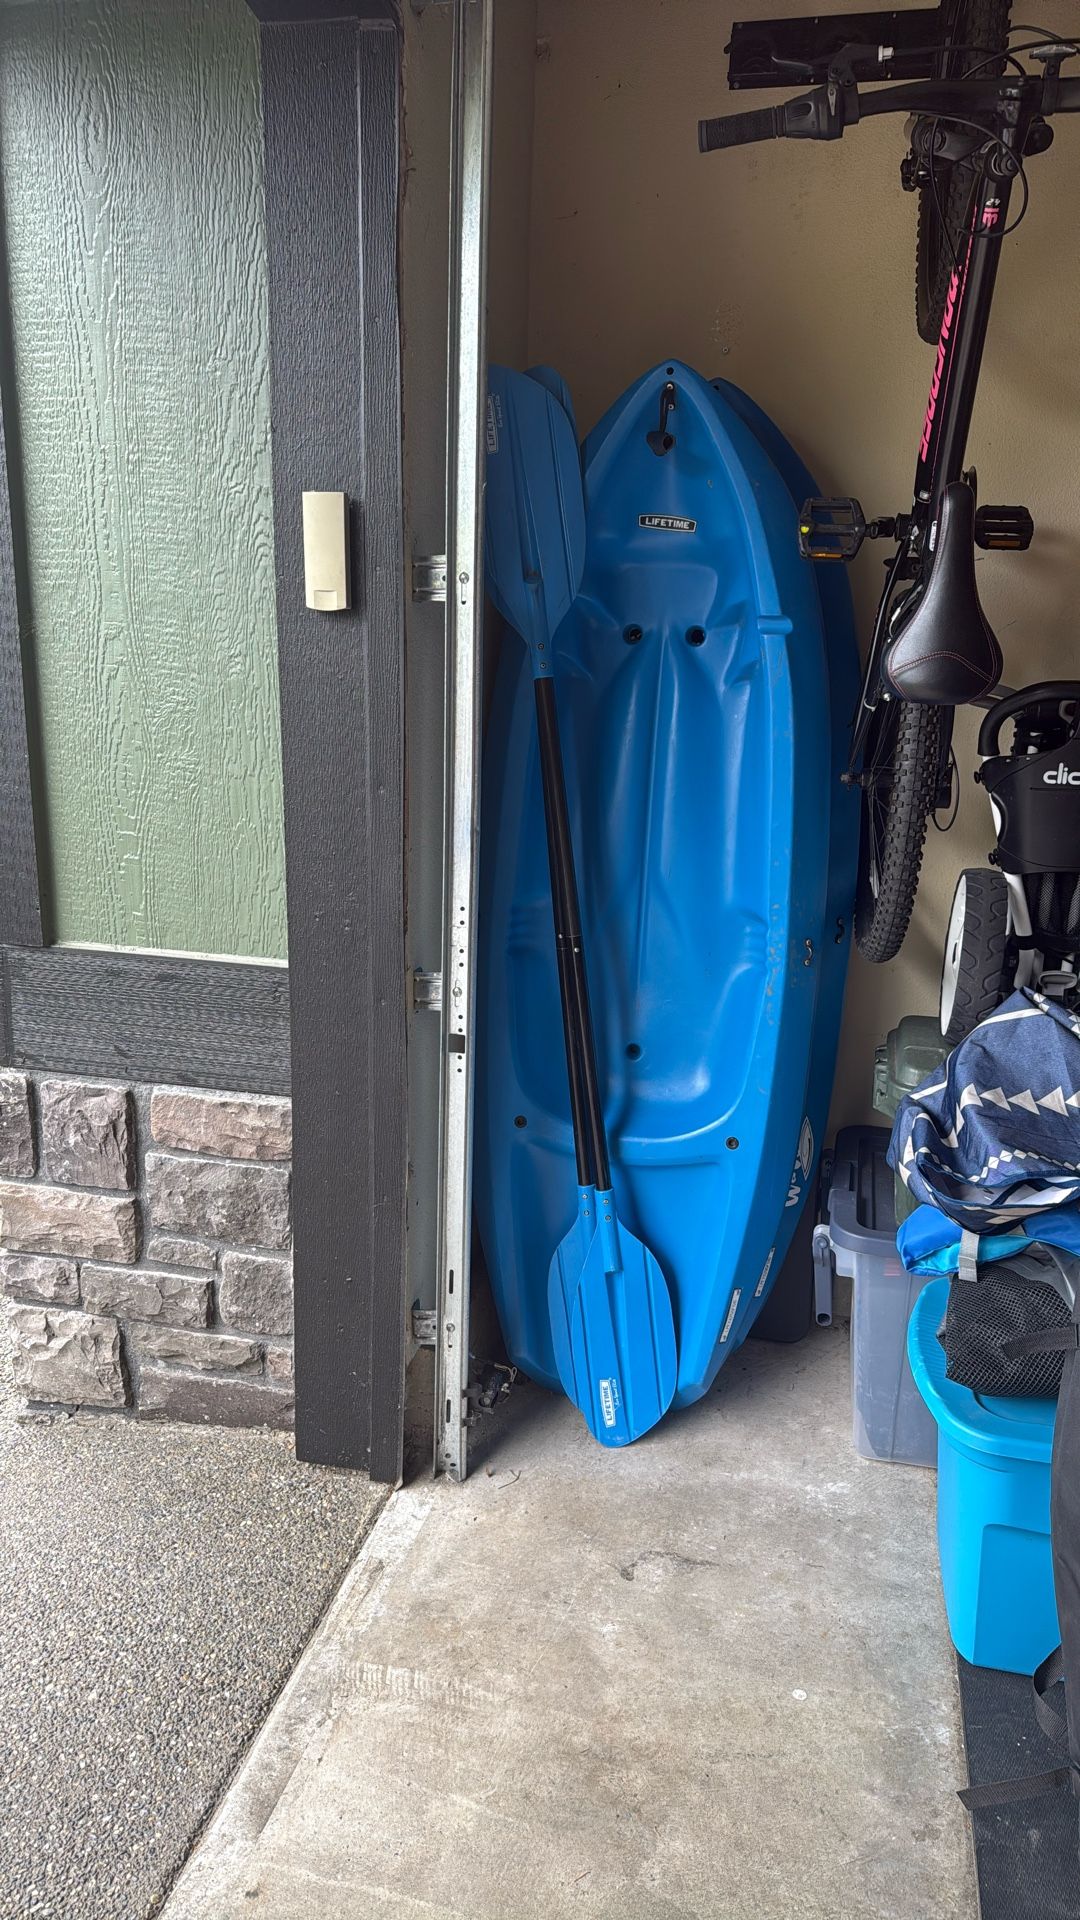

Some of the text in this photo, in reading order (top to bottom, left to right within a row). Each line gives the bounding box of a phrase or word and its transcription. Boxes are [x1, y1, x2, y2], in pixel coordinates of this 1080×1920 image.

[645, 516, 690, 530] LIFETIME
[785, 1147, 801, 1207] Wav
[602, 1385, 613, 1421] LIFETIME
